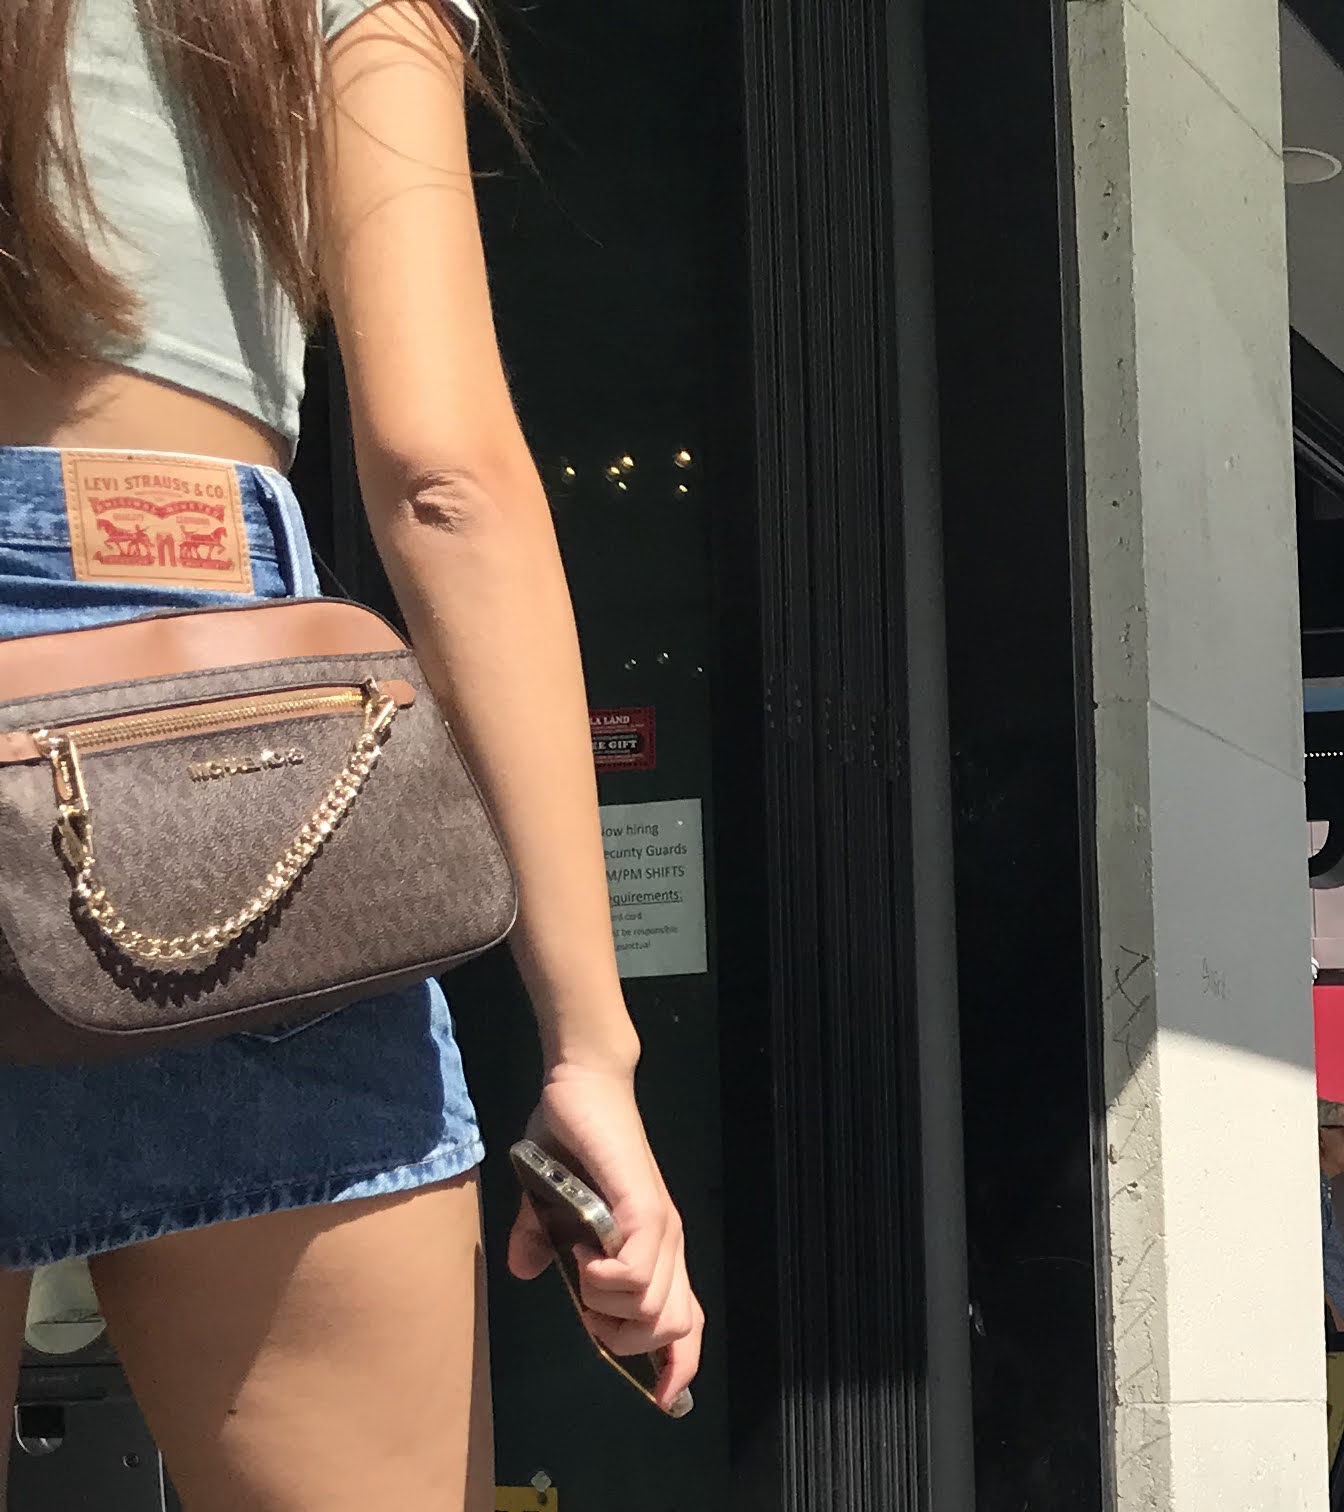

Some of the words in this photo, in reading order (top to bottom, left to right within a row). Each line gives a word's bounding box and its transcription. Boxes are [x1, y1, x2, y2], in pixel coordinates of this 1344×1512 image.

[84, 475, 118, 492] LEVI
[124, 474, 190, 496] STRAUSS
[193, 483, 203, 497] &
[603, 715, 630, 725] LAND
[608, 740, 637, 749] GIFT
[626, 823, 659, 836] hiring
[603, 849, 642, 861] ecurity
[646, 843, 687, 857] Guards
[606, 867, 642, 882] M/PM
[646, 865, 685, 880] SHIFTS
[608, 889, 683, 907] equirements.
